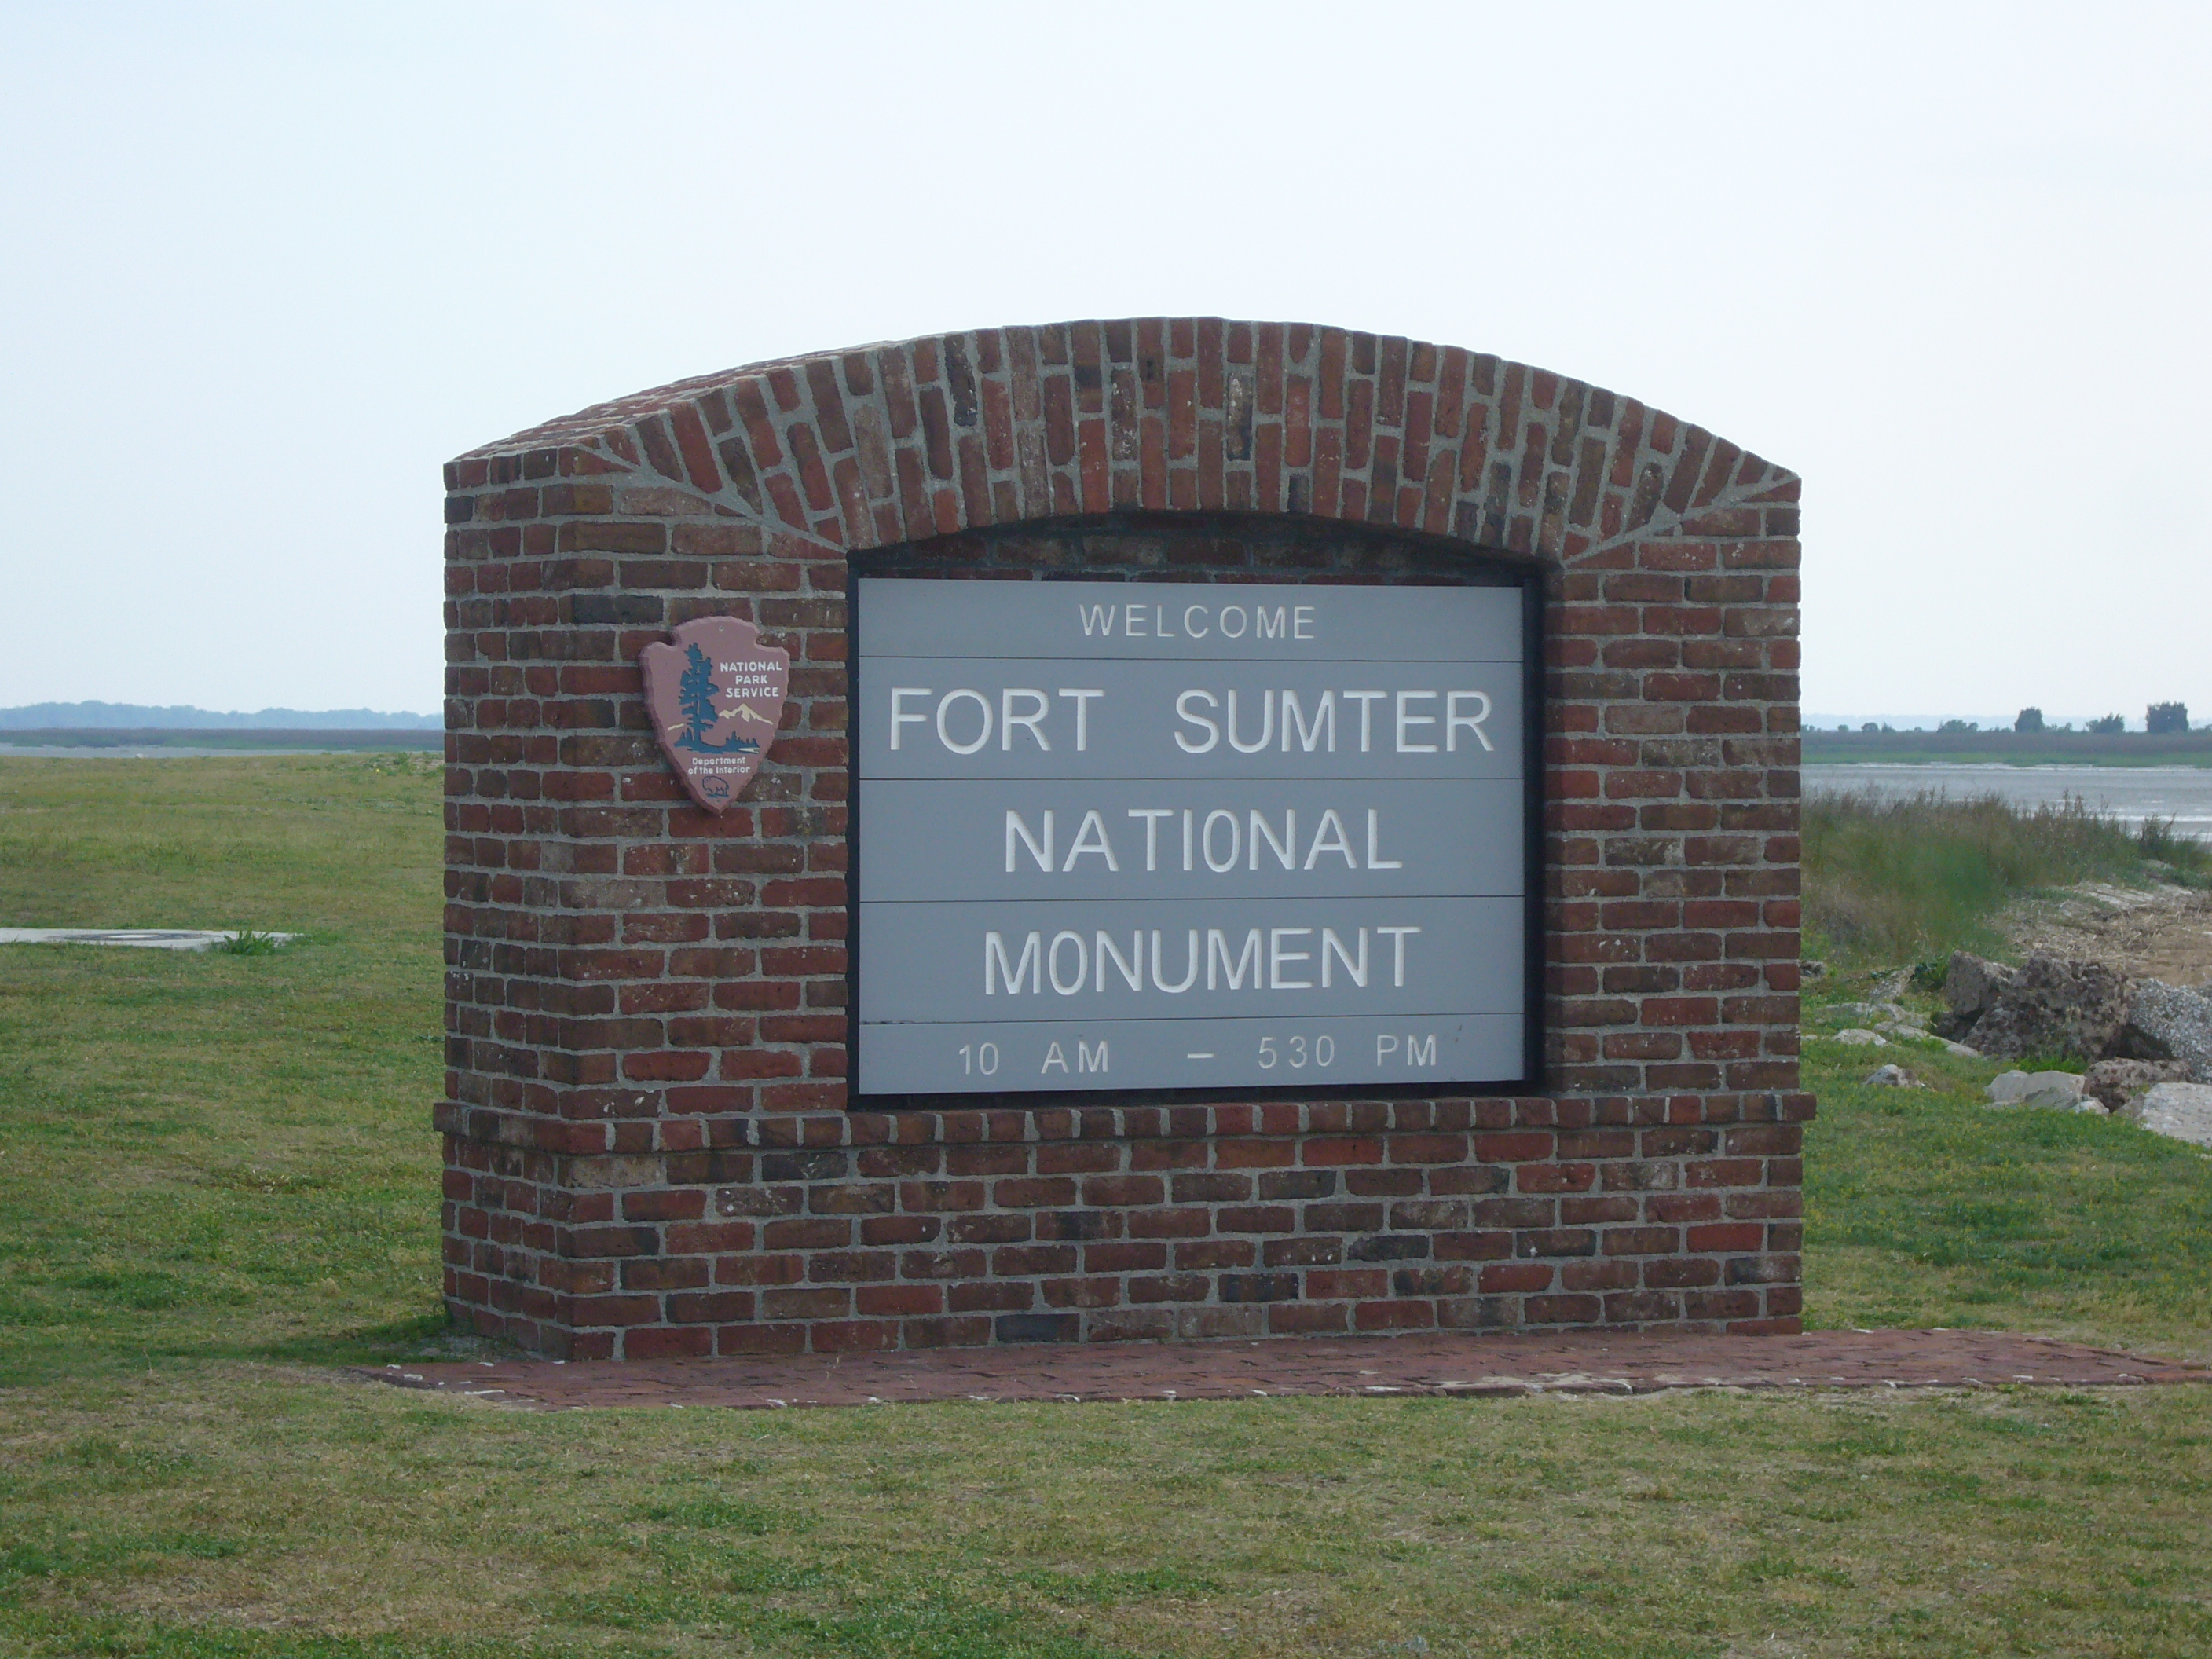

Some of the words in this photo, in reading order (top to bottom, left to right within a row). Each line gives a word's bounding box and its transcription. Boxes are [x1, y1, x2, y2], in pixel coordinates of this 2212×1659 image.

[1079, 603, 1316, 640] WELCOME
[720, 661, 782, 672] NATIONAL
[735, 675, 768, 684] PARK
[725, 687, 779, 698] SERVICE
[890, 687, 1104, 755] FORT
[1174, 689, 1495, 755] SUMTER
[688, 766, 698, 775] of
[699, 766, 713, 775] the
[716, 765, 751, 775] Interior
[692, 756, 746, 766] Department
[1005, 808, 1403, 873] NATIONAL
[985, 926, 1421, 996] MONUMENT
[958, 1042, 999, 1075] 10
[1040, 1041, 1109, 1075] AM
[1257, 1035, 1335, 1069] 530
[1376, 1033, 1437, 1067] PM
